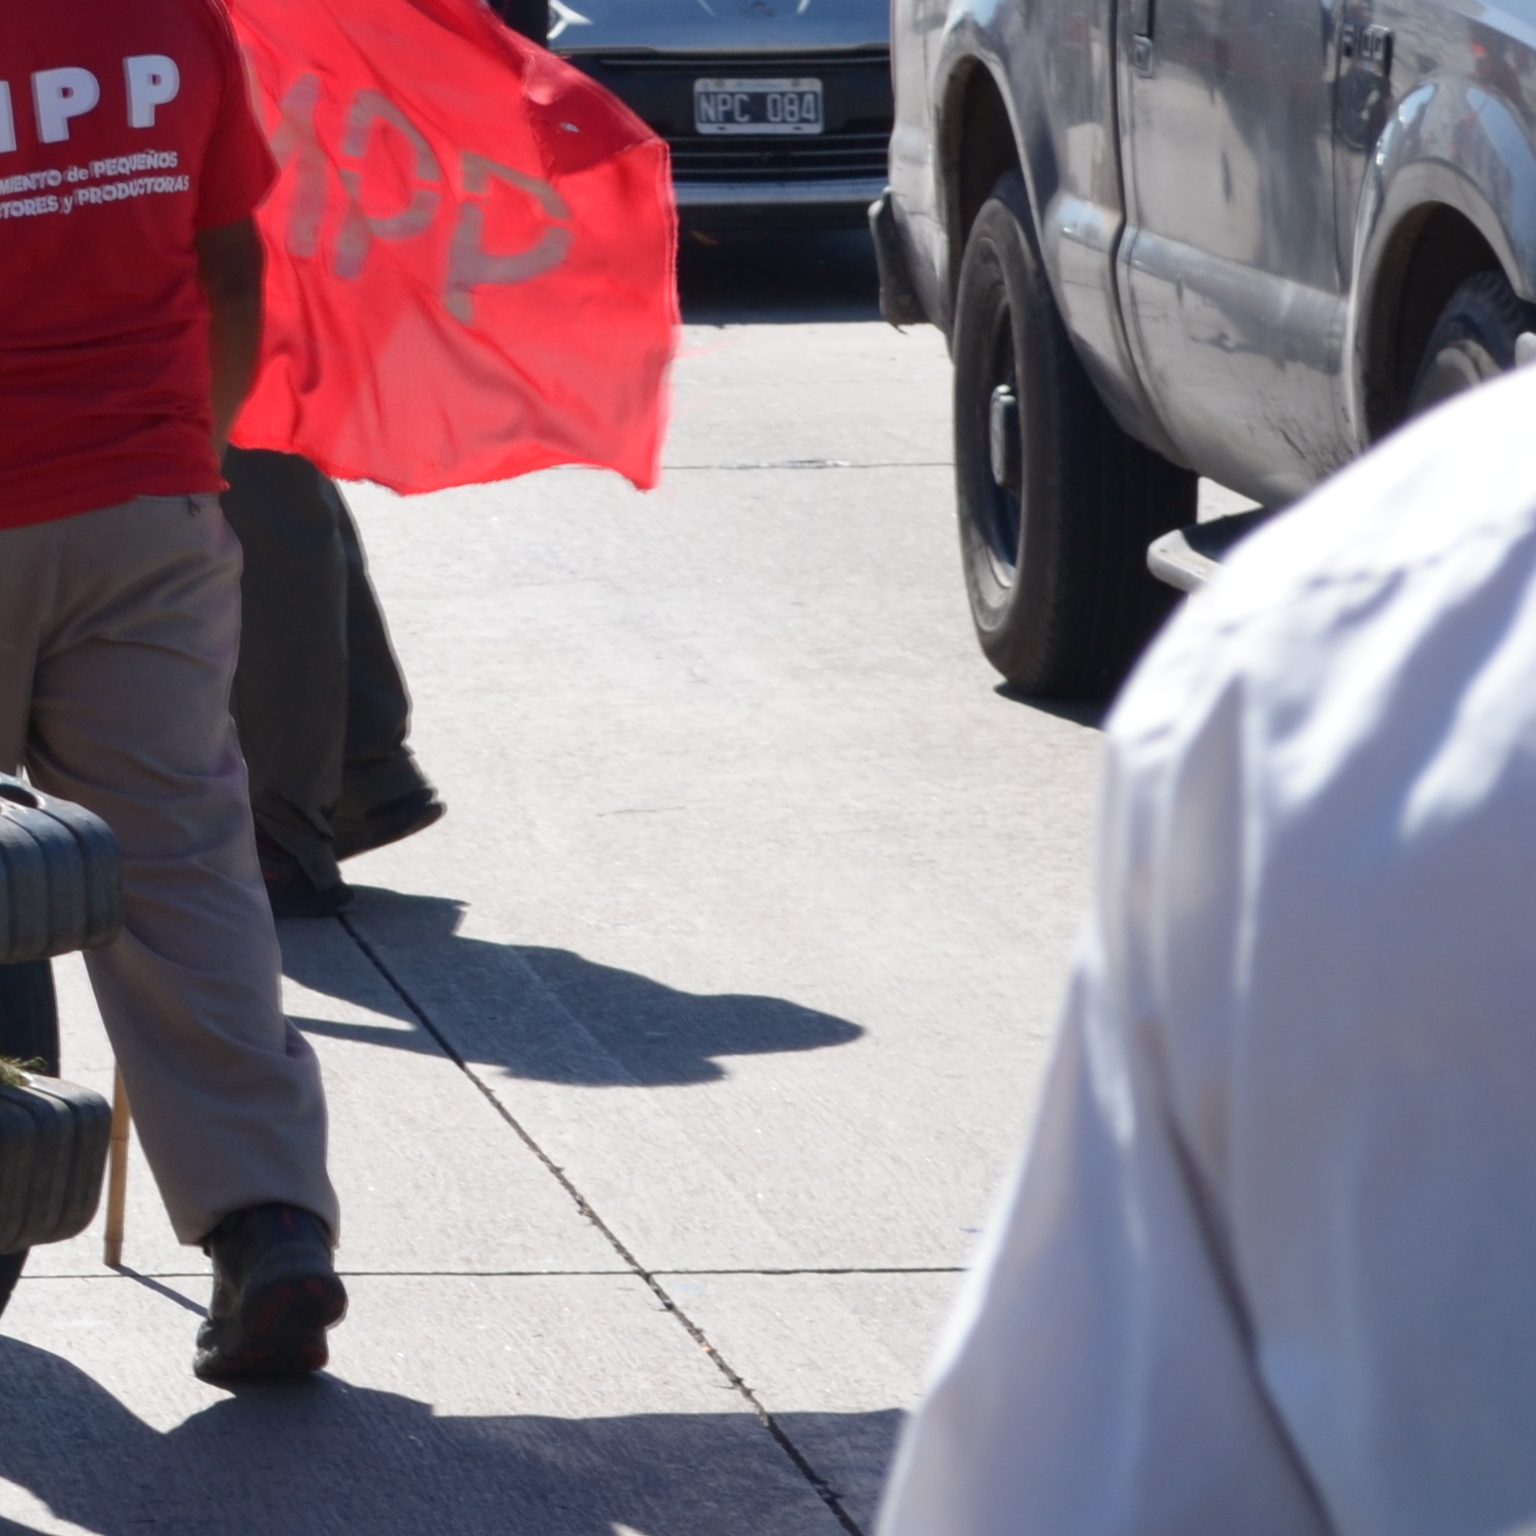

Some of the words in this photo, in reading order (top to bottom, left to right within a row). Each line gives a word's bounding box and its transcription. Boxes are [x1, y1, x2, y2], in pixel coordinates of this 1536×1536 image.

[699, 93, 750, 123] NPC
[766, 93, 817, 123] 084
[64, 166, 89, 183] de
[89, 149, 178, 178] PEQUEÑOS
[60, 196, 74, 214] y
[73, 175, 190, 206] PRODUCTORAS
